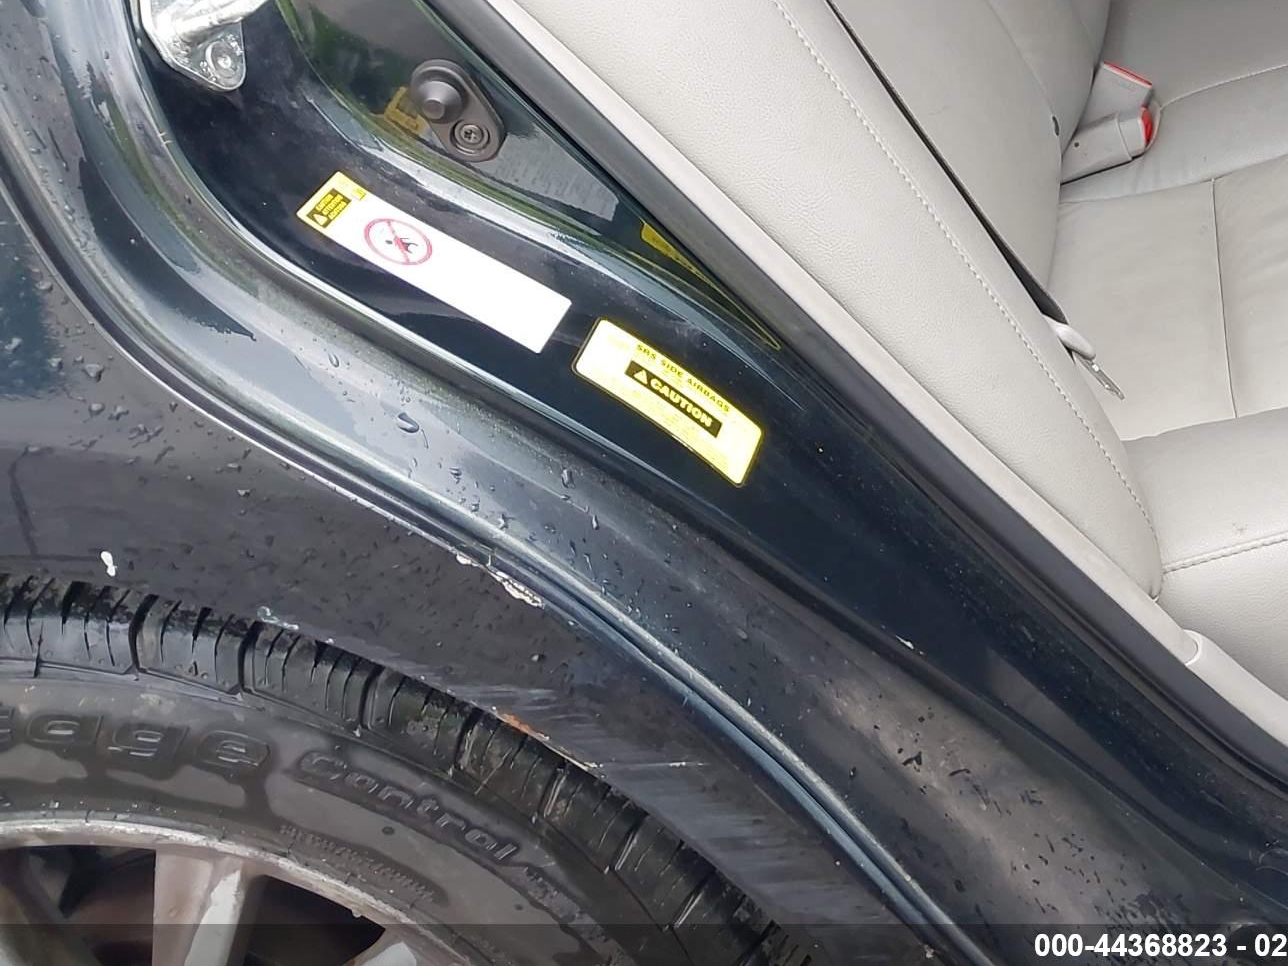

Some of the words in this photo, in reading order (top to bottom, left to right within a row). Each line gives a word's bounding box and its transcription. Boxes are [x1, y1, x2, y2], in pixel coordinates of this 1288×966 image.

[637, 344, 657, 360] SRS
[661, 360, 684, 377] SIDE
[687, 378, 730, 412] AIRBAGS
[649, 377, 714, 428] CAUTION
[300, 749, 520, 862] Control
